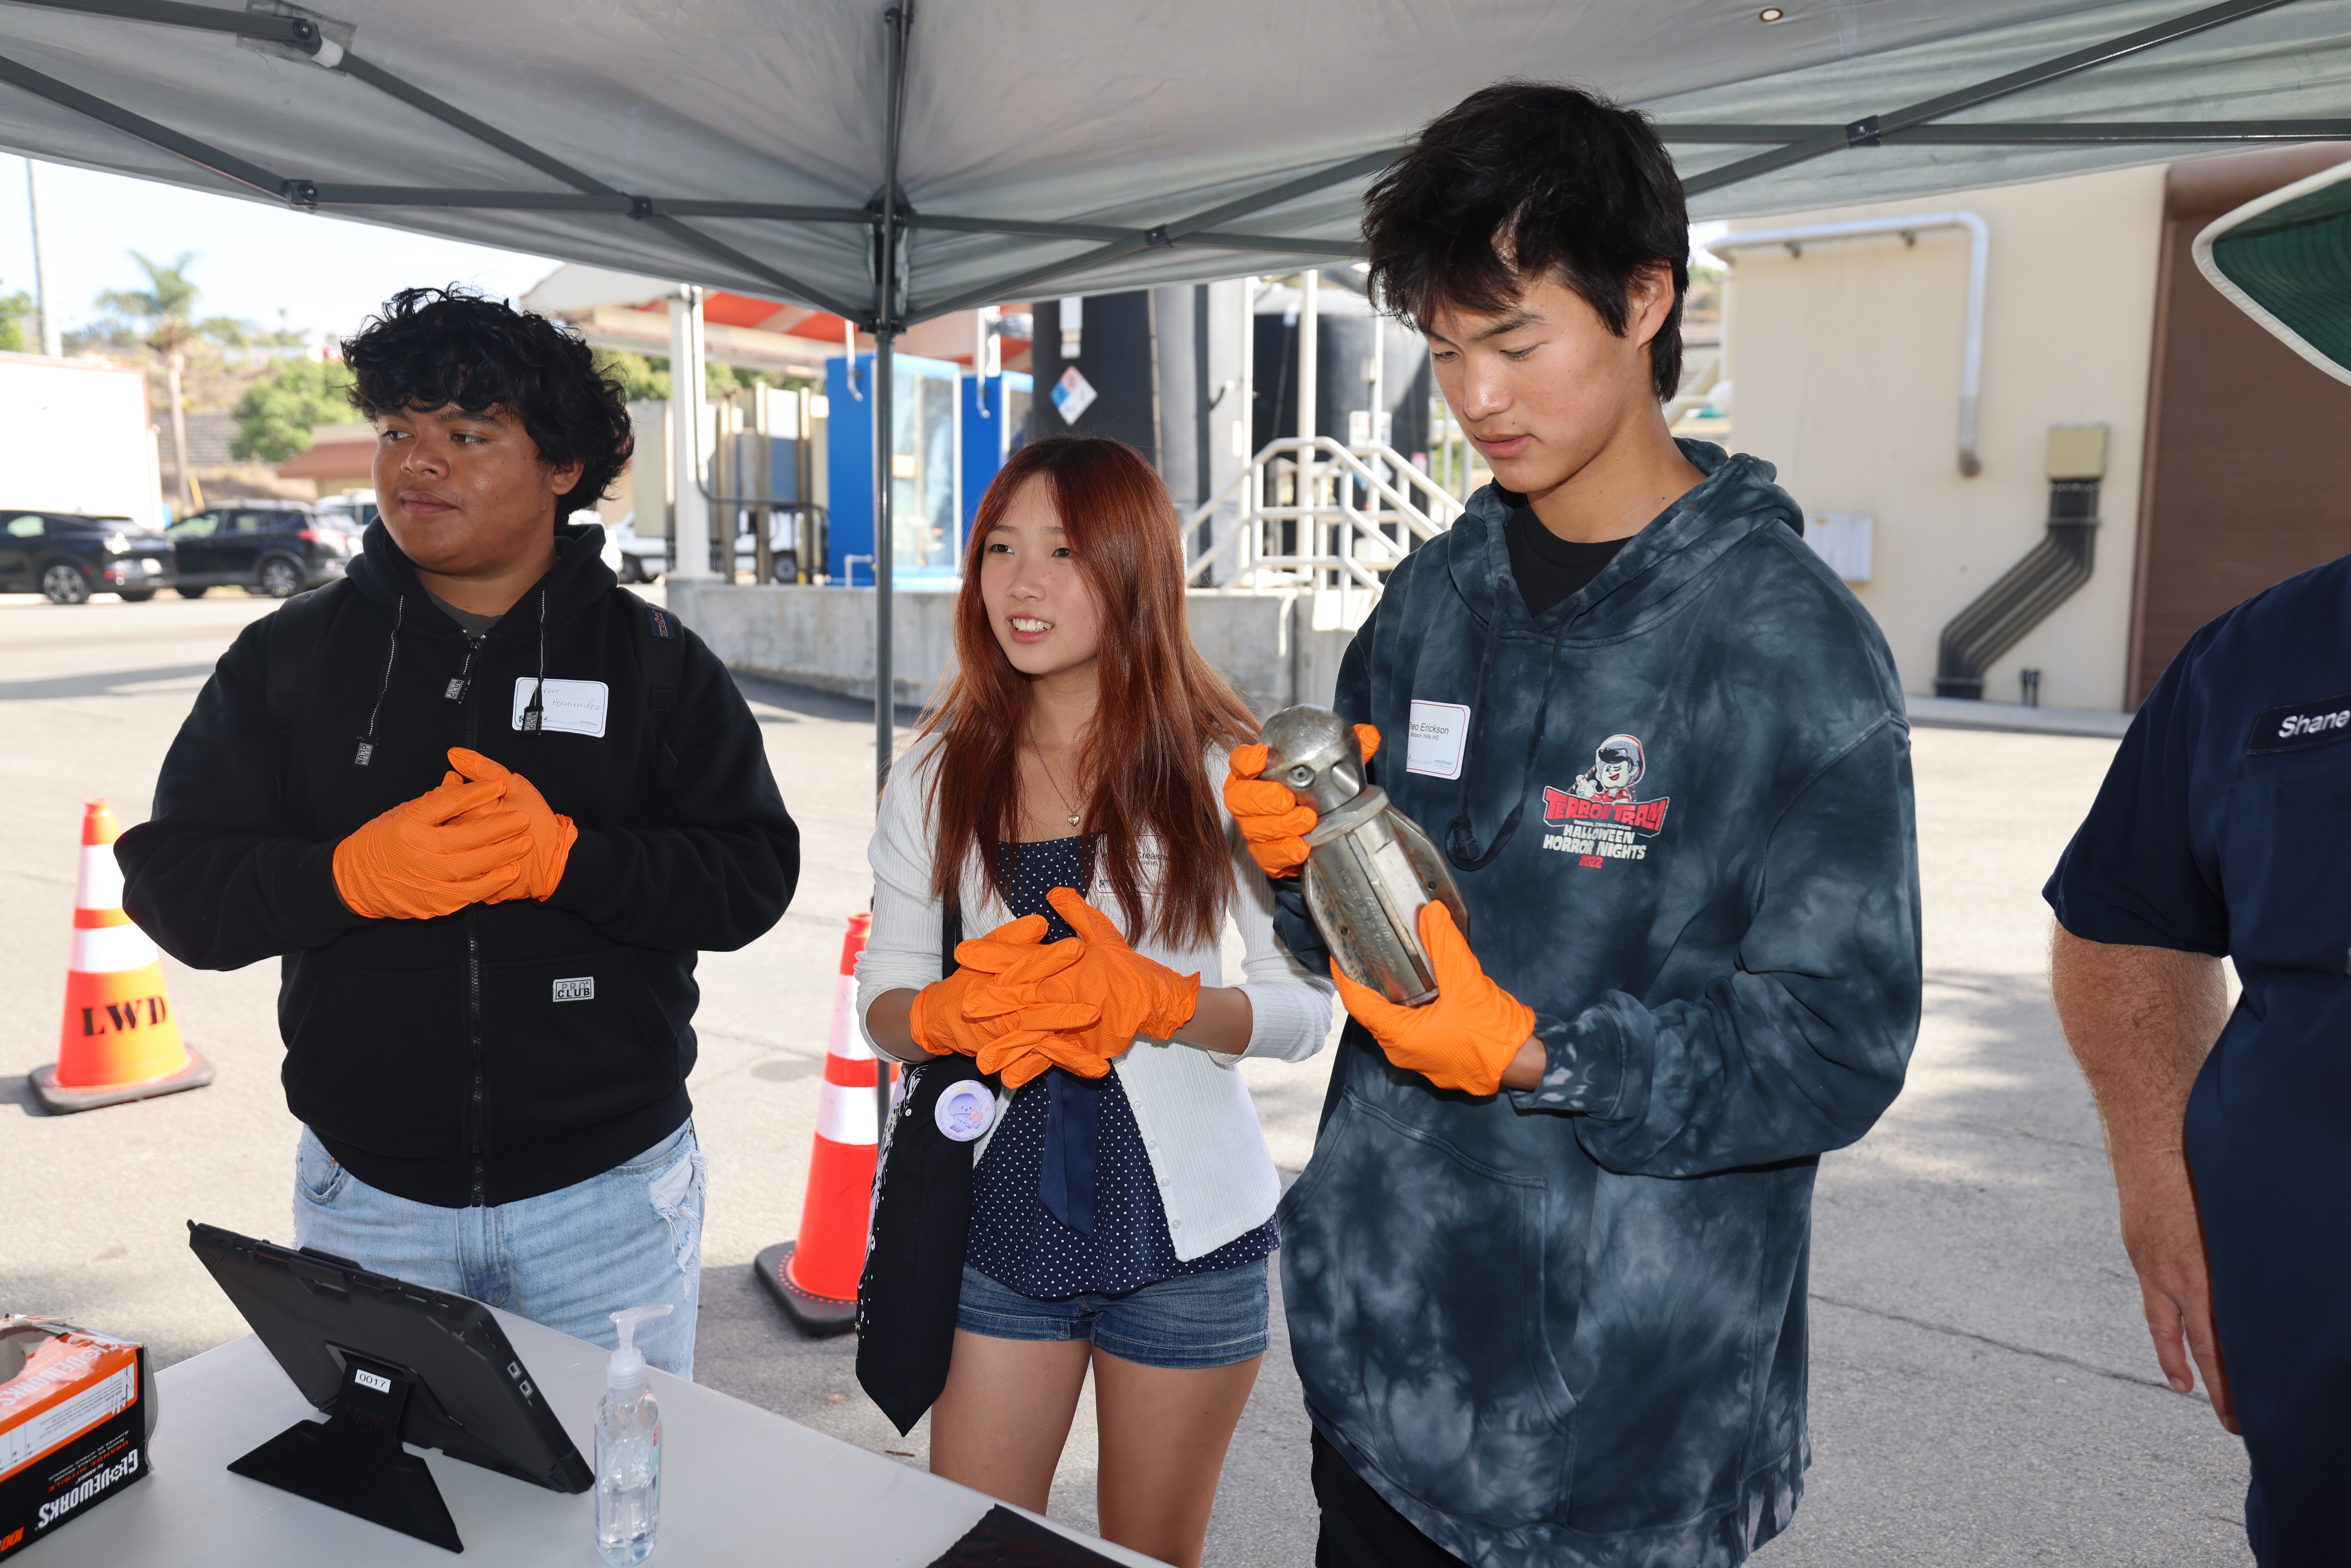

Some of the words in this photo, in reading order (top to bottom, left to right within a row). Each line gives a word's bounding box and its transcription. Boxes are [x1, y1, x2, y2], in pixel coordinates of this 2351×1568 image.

[450, 680, 461, 697] CLUB
[552, 698, 601, 710] Hernandez
[1420, 723, 1449, 735] Erickson
[2278, 710, 2351, 738] Shane
[357, 745, 366, 763] CLUB
[1545, 788, 1611, 820] TERROR
[1613, 799, 1668, 831] TRAM
[1563, 824, 1635, 844] HALLOWEEN
[1543, 834, 1596, 855] HORROR
[1596, 840, 1647, 860] NIGHTS
[1578, 855, 1604, 869] 2022
[558, 988, 590, 998] CLUB
[82, 996, 166, 1036] LWD
[942, 1127, 953, 1137] WITH
[359, 1373, 386, 1388] 0017
[91, 1440, 129, 1467] ORANGE
[38, 1449, 138, 1528] GLOVEWORKS
[48, 1467, 87, 1493] NITRILE
